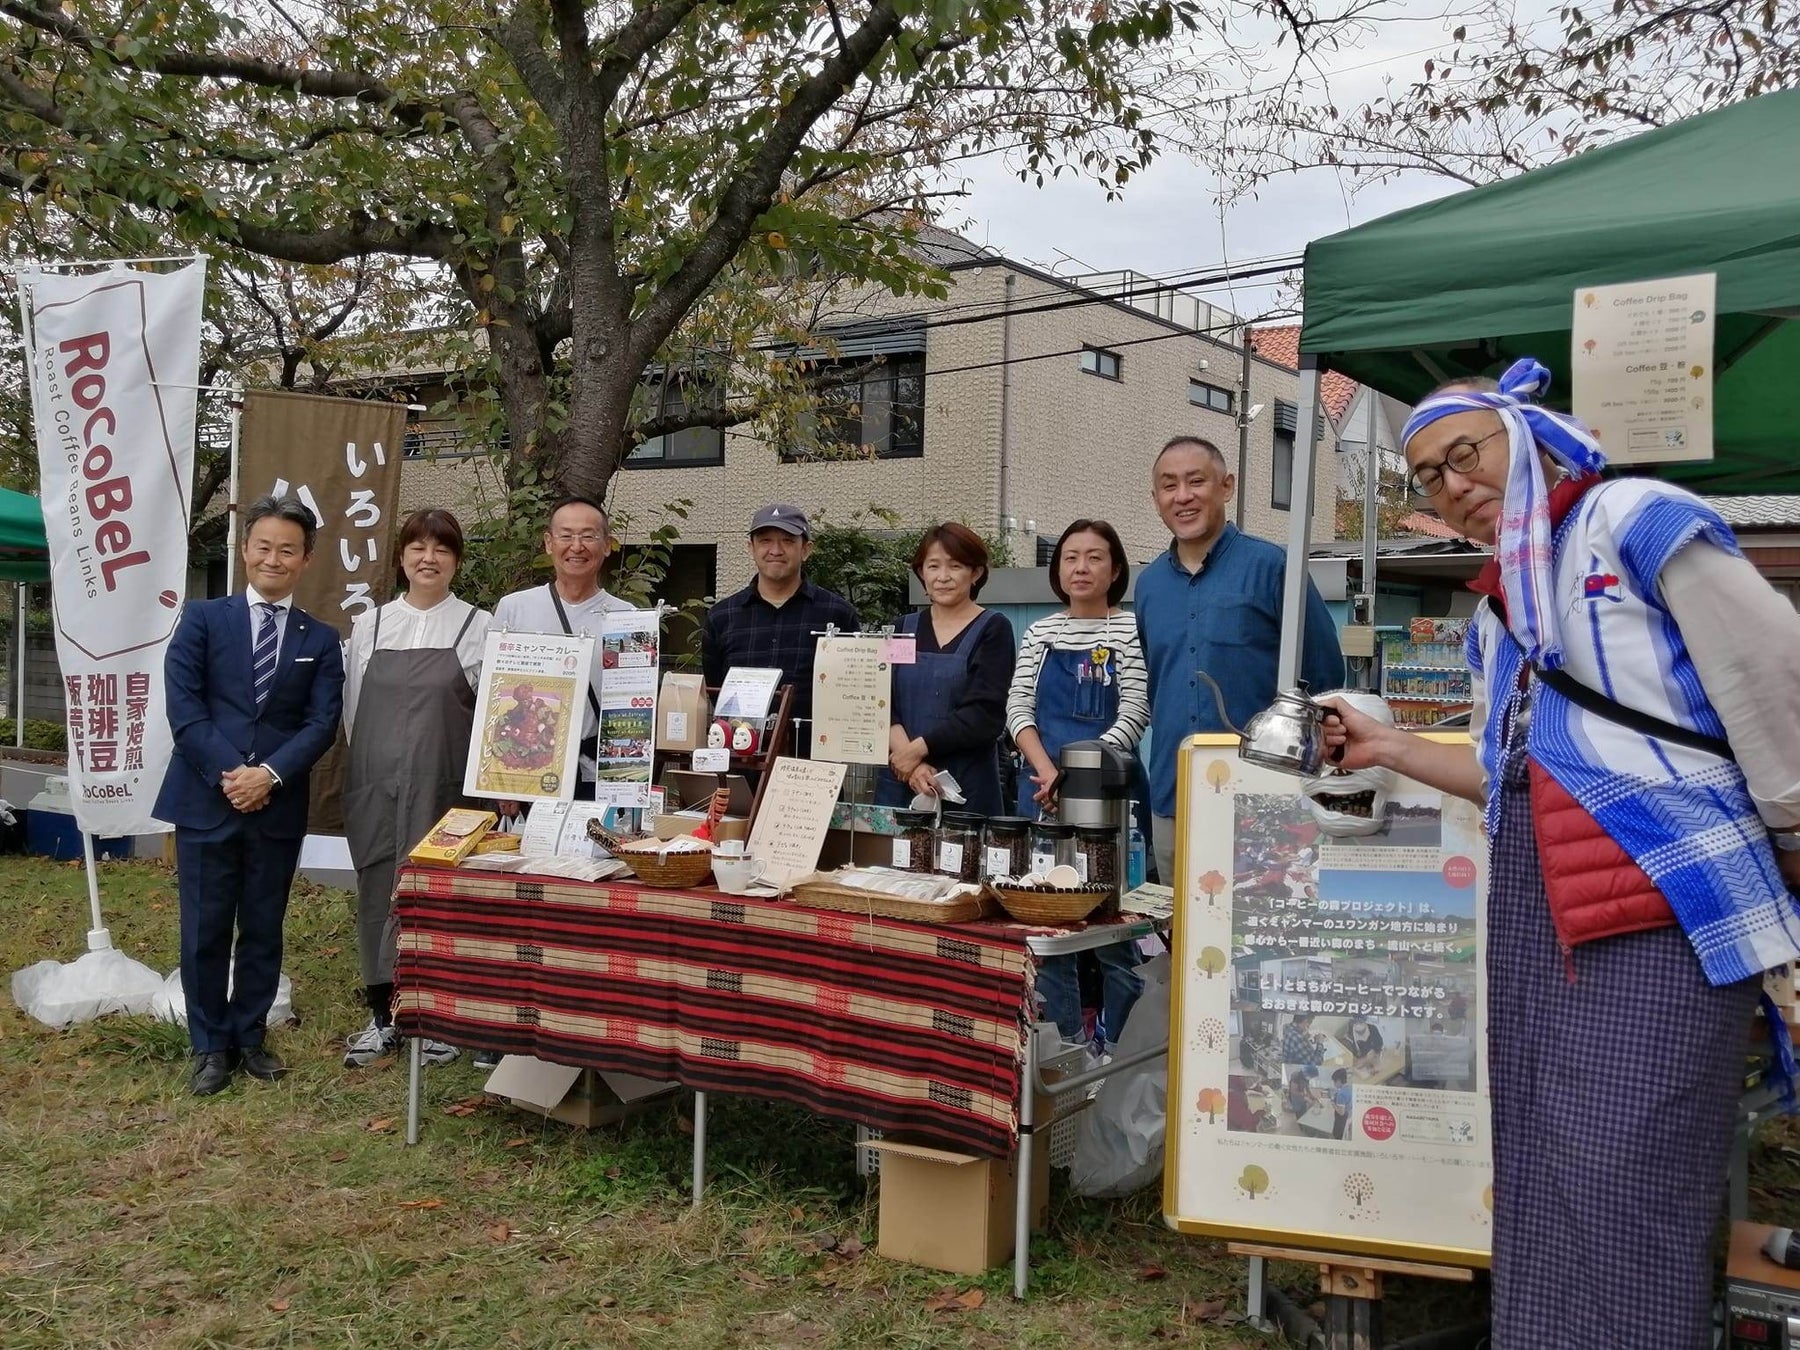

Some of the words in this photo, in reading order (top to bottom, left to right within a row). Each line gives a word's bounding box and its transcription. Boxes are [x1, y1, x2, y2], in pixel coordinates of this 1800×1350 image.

[1612, 297, 1644, 307] Coffee
[1646, 295, 1667, 304] Drip
[1668, 292, 1688, 302] Bag
[1625, 364, 1657, 374] Coffee
[44, 346, 62, 403] Roast
[54, 409, 79, 475] Coffee
[69, 481, 83, 538] Beans
[76, 544, 97, 599] Links
[59, 331, 151, 592] RoCoBeL
[340, 442, 386, 624] いろいろ
[866, 647, 878, 655] Bag
[87, 673, 119, 772] 珈琲豆
[123, 672, 150, 771] 自家焙煎
[1259, 979, 1446, 999] ヒトとまちがコーヒーでつながる
